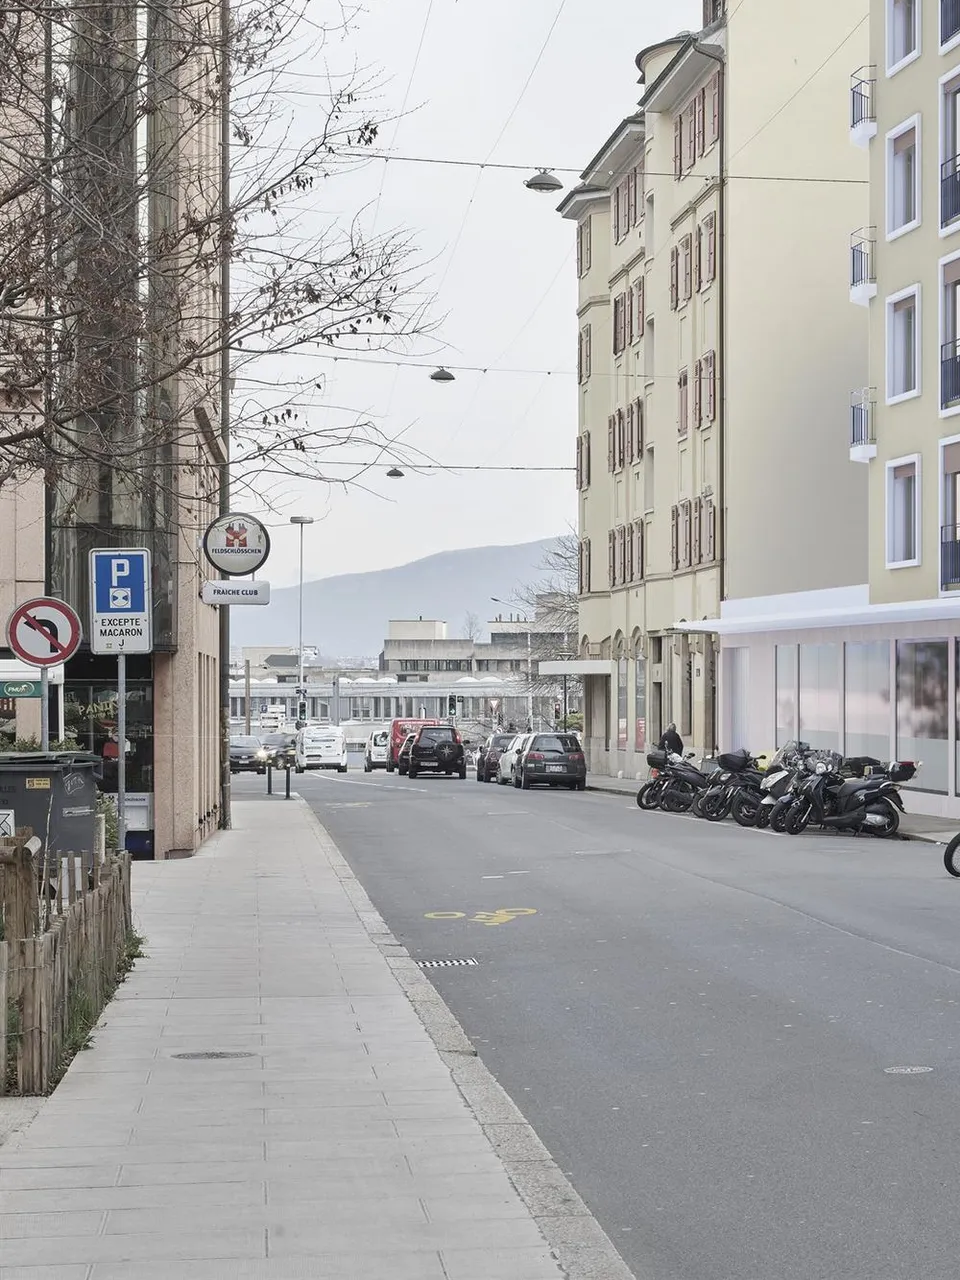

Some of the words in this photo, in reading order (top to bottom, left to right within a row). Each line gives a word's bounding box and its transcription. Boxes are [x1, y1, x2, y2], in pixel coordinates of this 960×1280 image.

[111, 559, 130, 587] P
[101, 618, 140, 626] EXCEPTE
[100, 628, 142, 637] MACARON
[118, 639, 125, 647] J
